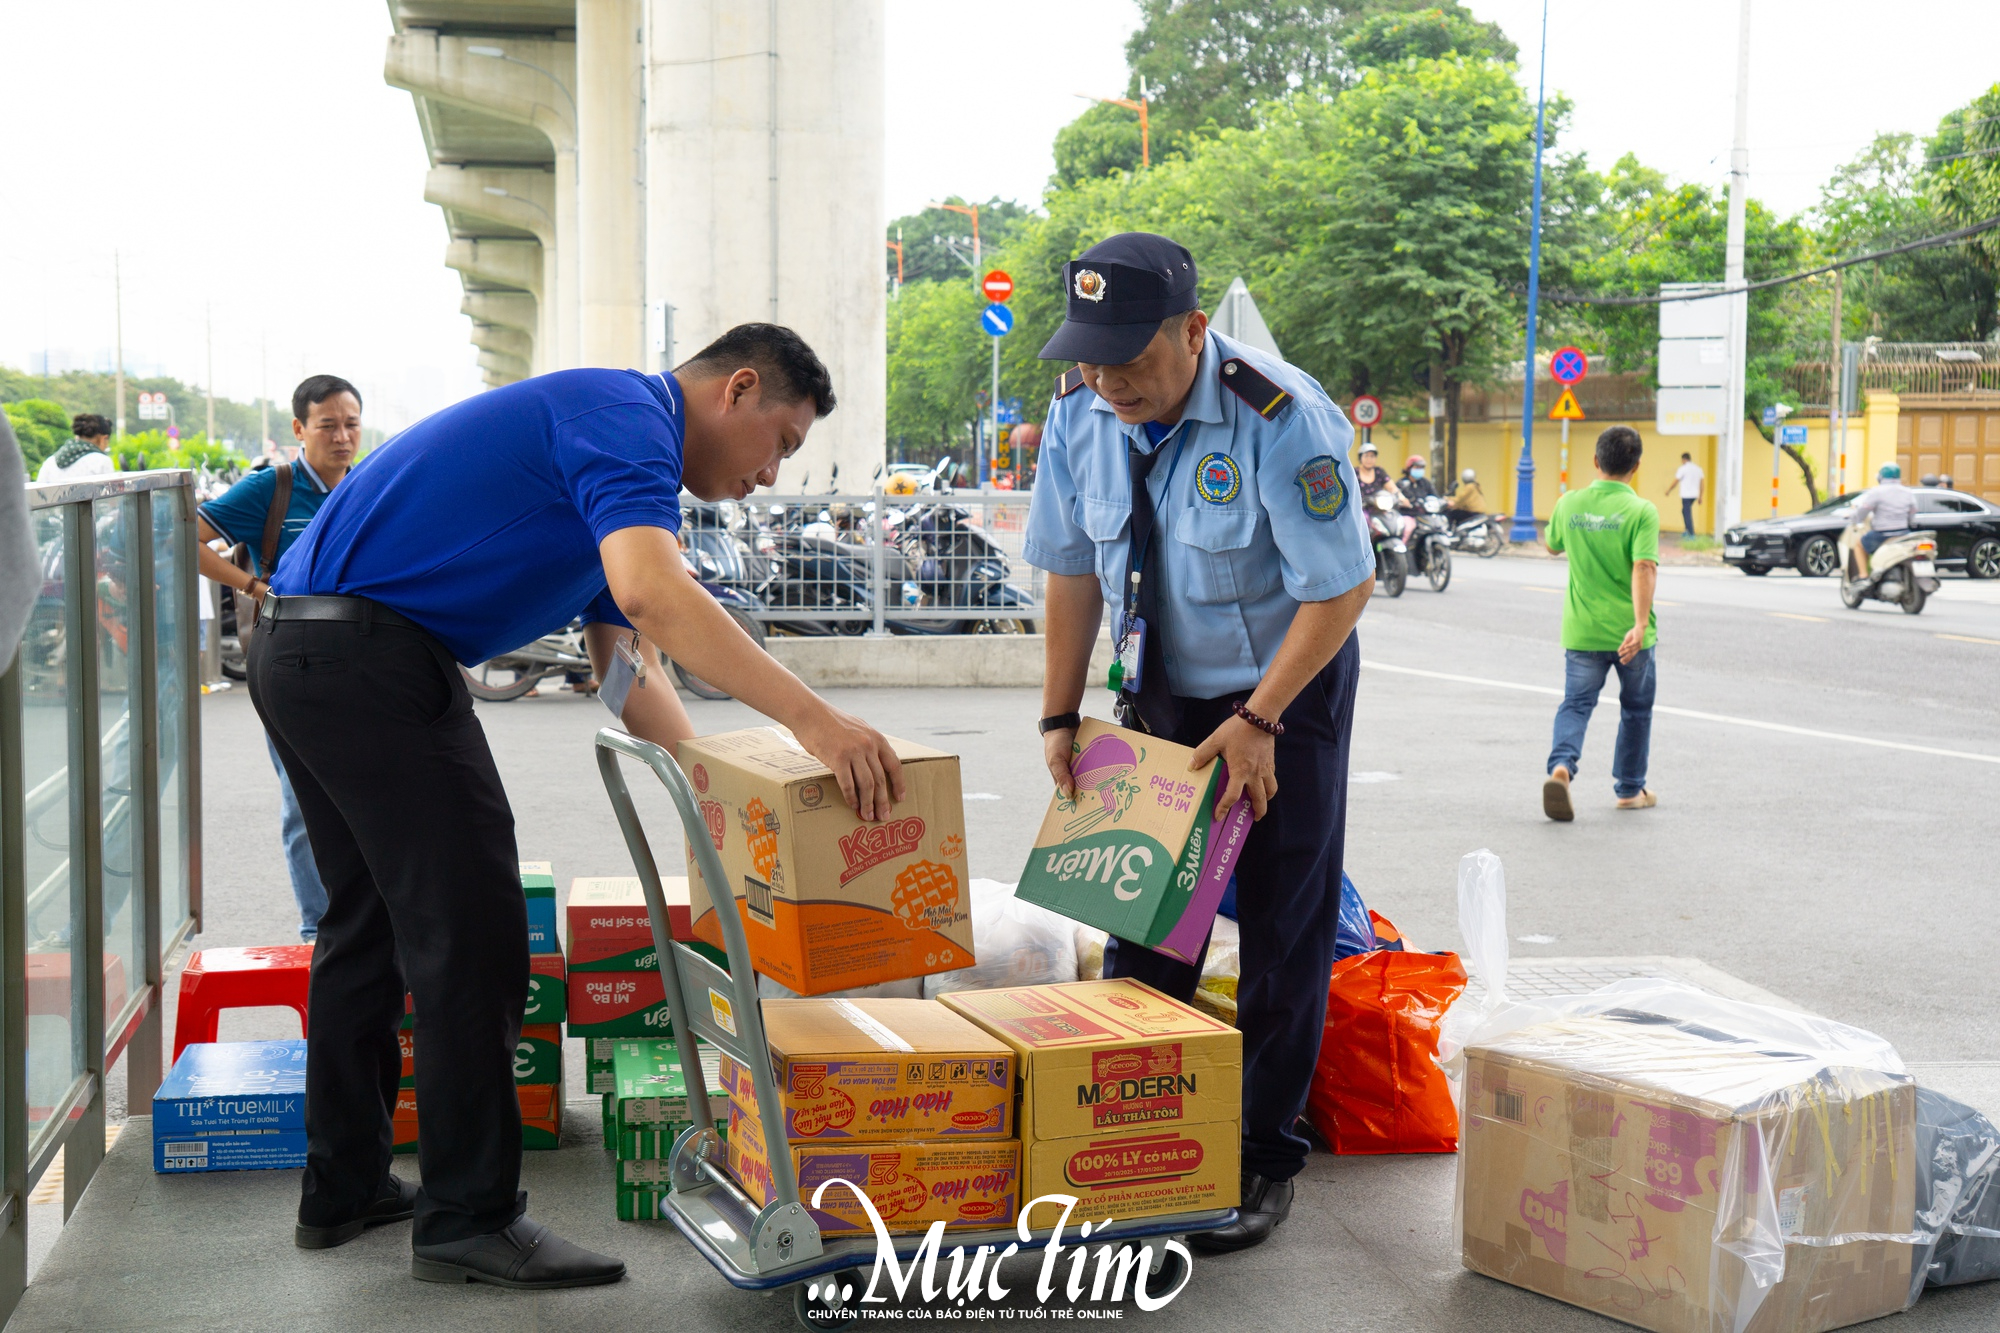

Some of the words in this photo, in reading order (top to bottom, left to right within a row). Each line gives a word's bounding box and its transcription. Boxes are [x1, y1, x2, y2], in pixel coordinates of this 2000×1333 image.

[1360, 404, 1374, 418] 50
[998, 430, 1010, 468] PHỞ
[1208, 468, 1228, 481] TVS
[1205, 478, 1230, 487] SECURITY
[1308, 474, 1335, 493] TVS
[1312, 486, 1336, 500] SECURITY
[1150, 774, 1174, 792] Phở
[1177, 780, 1196, 798] Sợi
[1156, 794, 1174, 808] Gà
[1174, 801, 1191, 813] Mì
[700, 800, 726, 837] aro
[839, 817, 925, 868] Karo
[1213, 864, 1225, 882] Mì
[1221, 847, 1233, 864] Gà
[1228, 825, 1241, 846] Sợi
[1237, 799, 1252, 825] Phở
[844, 864, 864, 878] TRỨNG
[864, 856, 878, 868] TƯƠI
[882, 850, 895, 859] CHÀ
[895, 843, 912, 854] BÔNG
[924, 906, 936, 918] Phô
[938, 905, 952, 915] Mai
[590, 918, 614, 928] Phở
[616, 916, 634, 928] Sợi
[930, 915, 953, 927] Hoàng
[954, 912, 968, 922] Kim
[586, 982, 612, 994] Phở
[616, 980, 636, 993] Sợi
[592, 994, 610, 1004] Bò
[614, 994, 630, 1004] Mì
[792, 1074, 826, 1100] 25
[872, 1078, 886, 1086] TÔM
[1077, 1073, 1196, 1108] MODERN
[175, 1102, 202, 1117] TH
[812, 1104, 827, 1116] mọi
[869, 1096, 910, 1124] Hảo
[913, 1090, 953, 1117] Hảo
[1122, 1101, 1143, 1110] HƯƠNG
[231, 1117, 248, 1125] Trùng
[814, 1114, 832, 1127] mọi
[1096, 1110, 1120, 1125] LẨU
[1122, 1108, 1151, 1123] THÁI
[1153, 1105, 1178, 1119] TÔM
[1074, 1154, 1119, 1172] 100%
[1123, 1150, 1142, 1166] LY
[1144, 1150, 1160, 1163] CÓ
[1162, 1149, 1179, 1161] MÃ
[1181, 1149, 1197, 1160] QR
[740, 1153, 753, 1186] Hảo
[754, 1158, 767, 1192] Hảo
[870, 1162, 900, 1186] 25
[1137, 1166, 1166, 1174] 17/01/2026
[932, 1176, 970, 1204] Hảo
[972, 1171, 1009, 1197] Hảo
[887, 1190, 901, 1200] mọi
[1095, 1192, 1106, 1204] CỔ
[1108, 1190, 1132, 1202] PHẦN
[1134, 1188, 1174, 1200] ACECOOK
[1176, 1185, 1195, 1196] VIỆT
[1196, 1183, 1216, 1192] NAM
